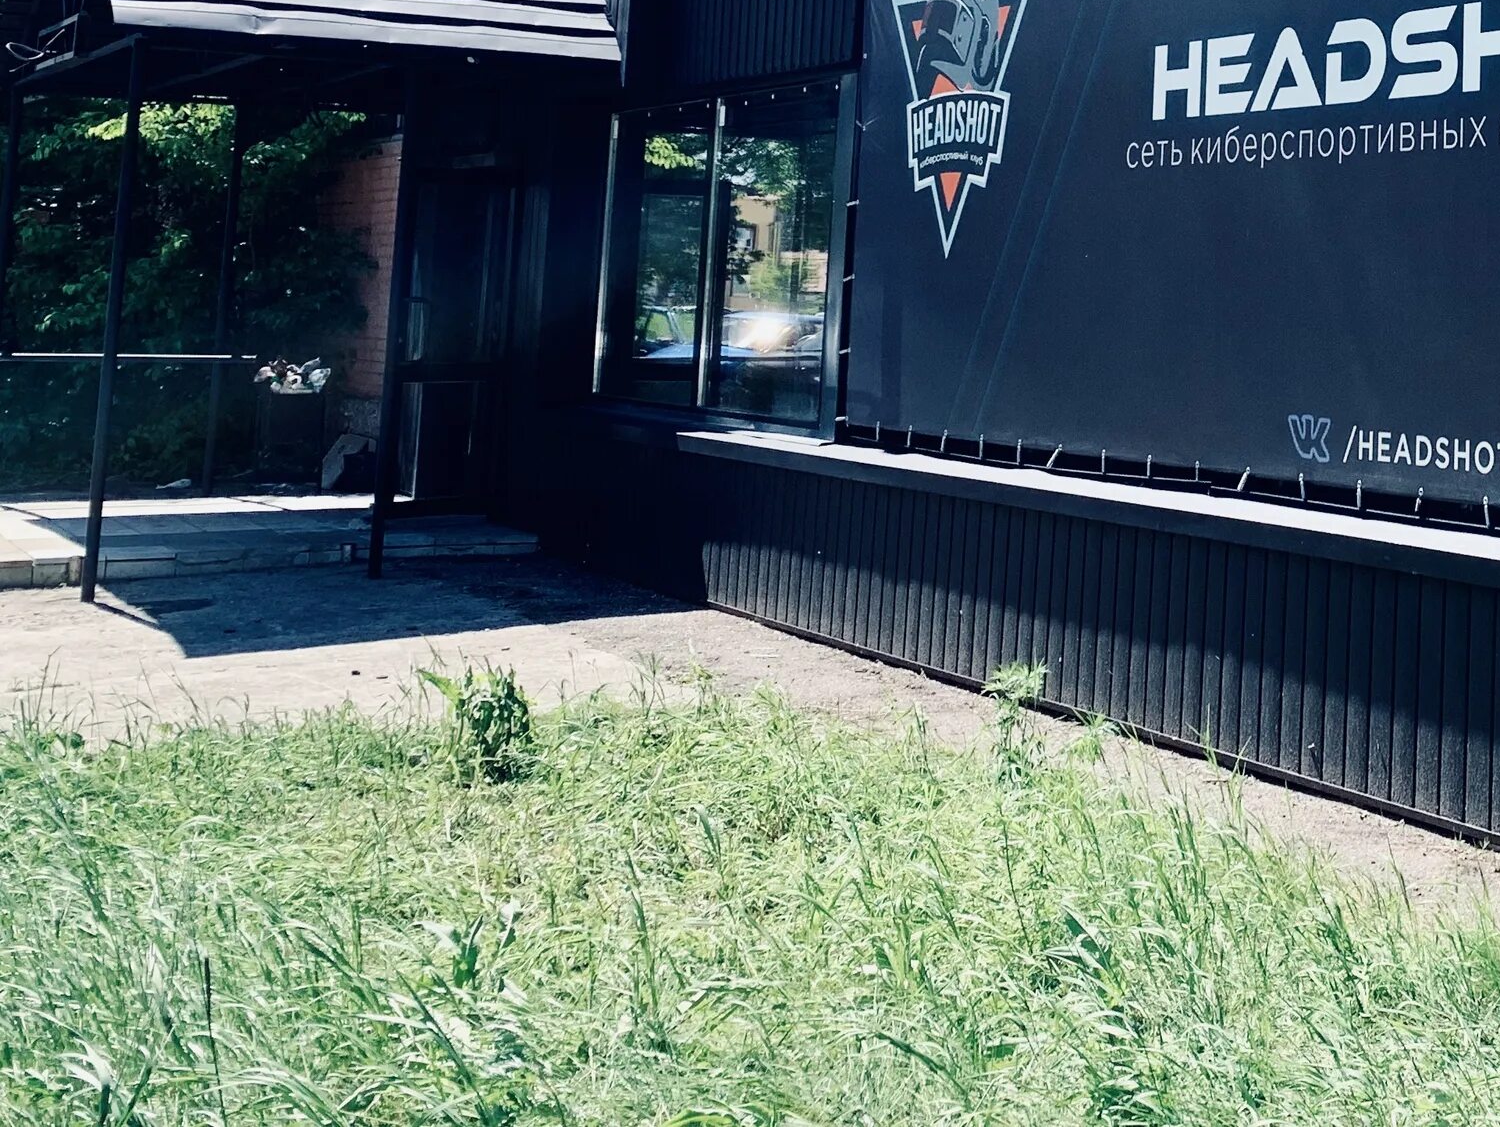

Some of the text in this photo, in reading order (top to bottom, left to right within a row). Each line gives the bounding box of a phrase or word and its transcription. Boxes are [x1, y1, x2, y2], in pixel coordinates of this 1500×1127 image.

[913, 100, 1001, 153] HEADSHOT
[1126, 140, 1183, 169] сеть
[1191, 115, 1487, 169] киберспортивных
